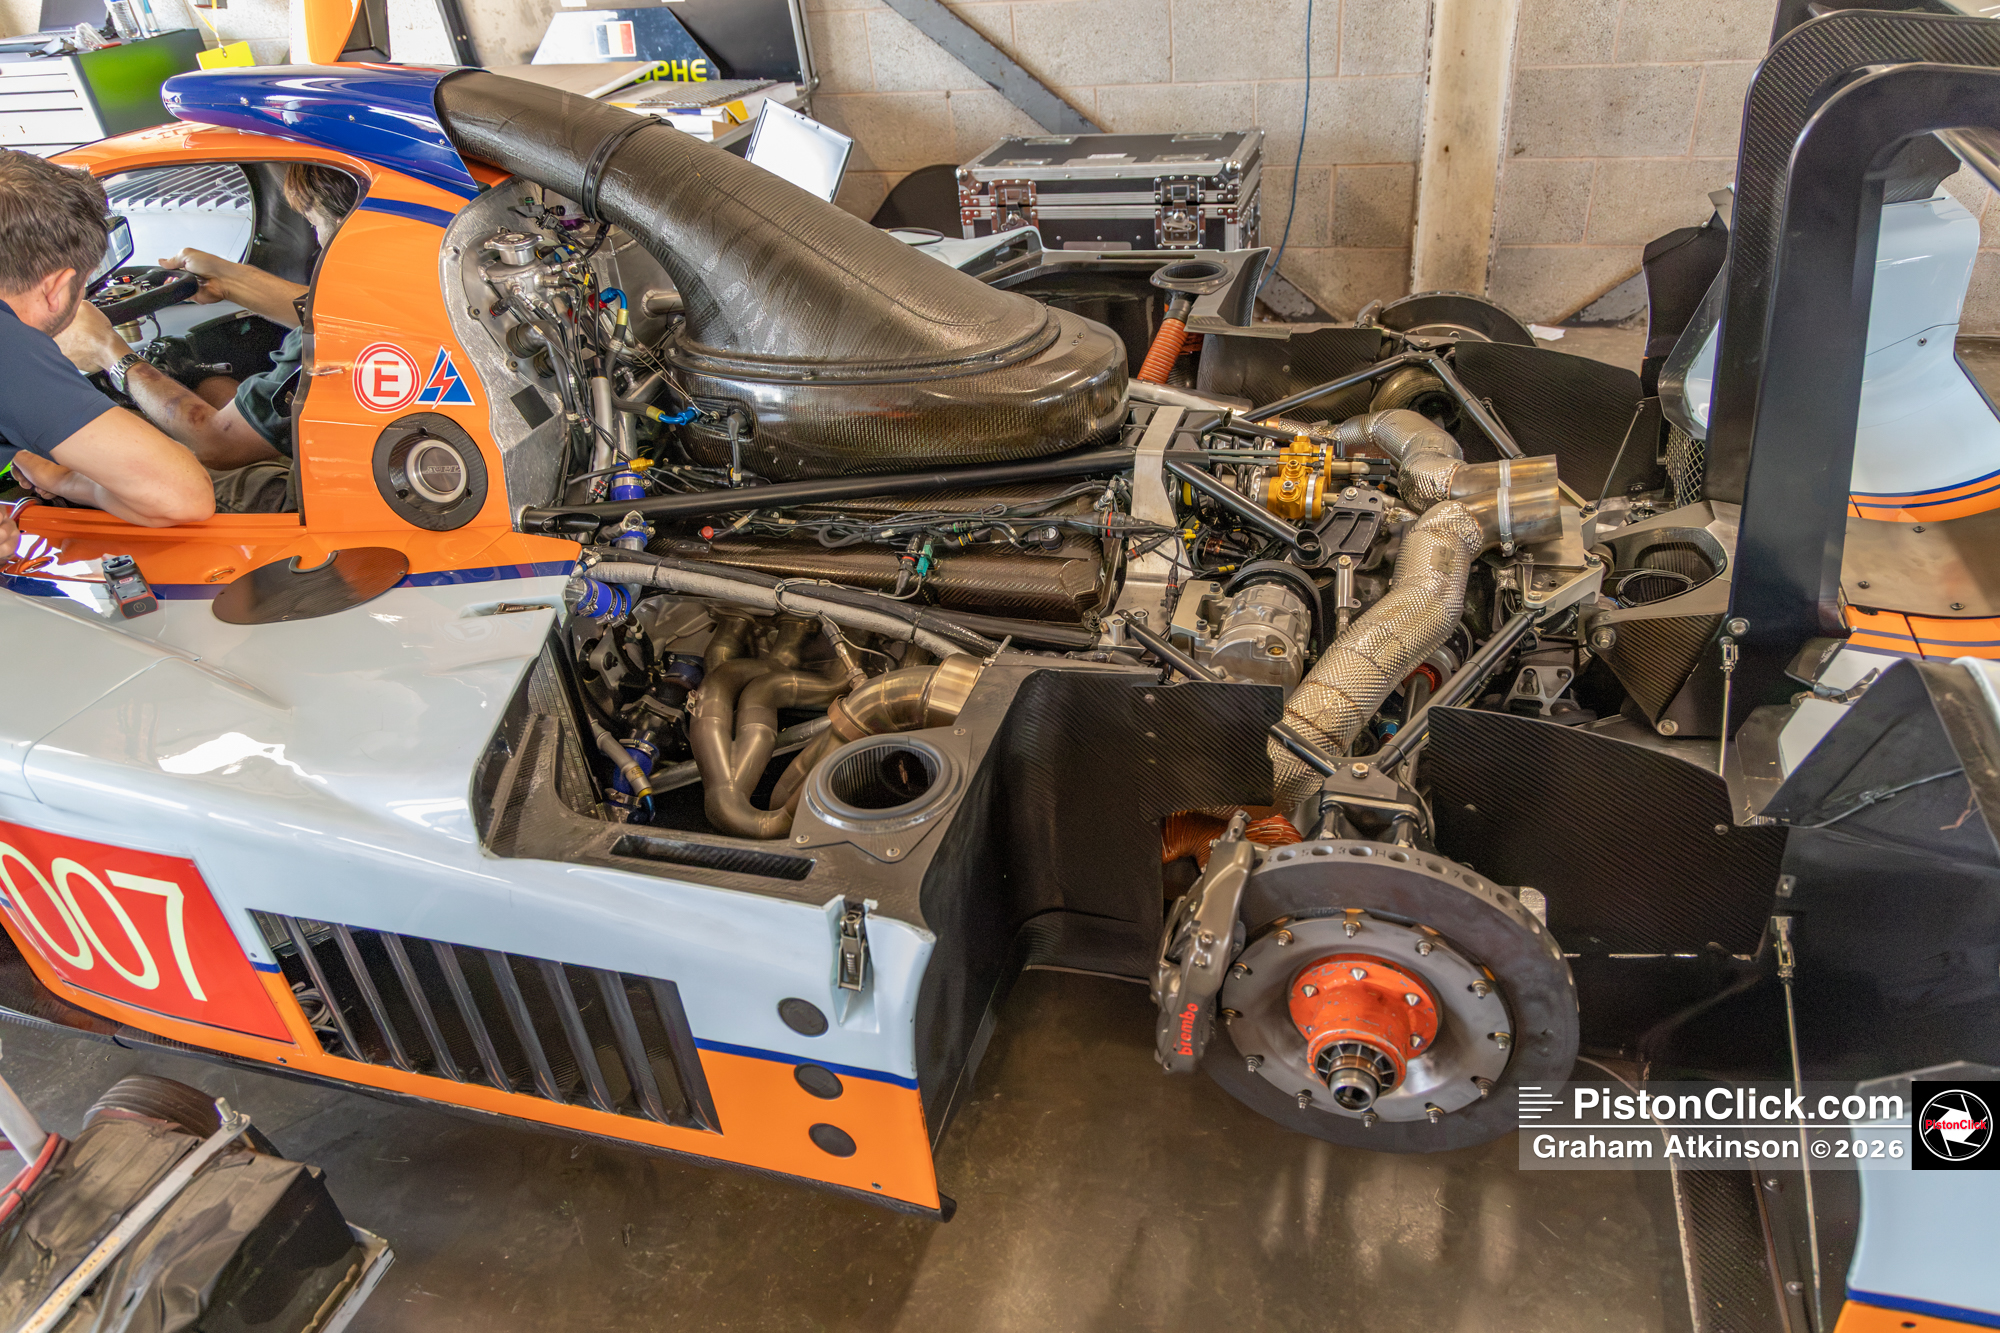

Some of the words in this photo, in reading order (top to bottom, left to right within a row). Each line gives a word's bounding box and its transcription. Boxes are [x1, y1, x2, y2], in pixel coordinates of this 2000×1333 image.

[373, 361, 400, 397] E
[0, 841, 207, 1001] 007
[1178, 1003, 1198, 1055] brembo
